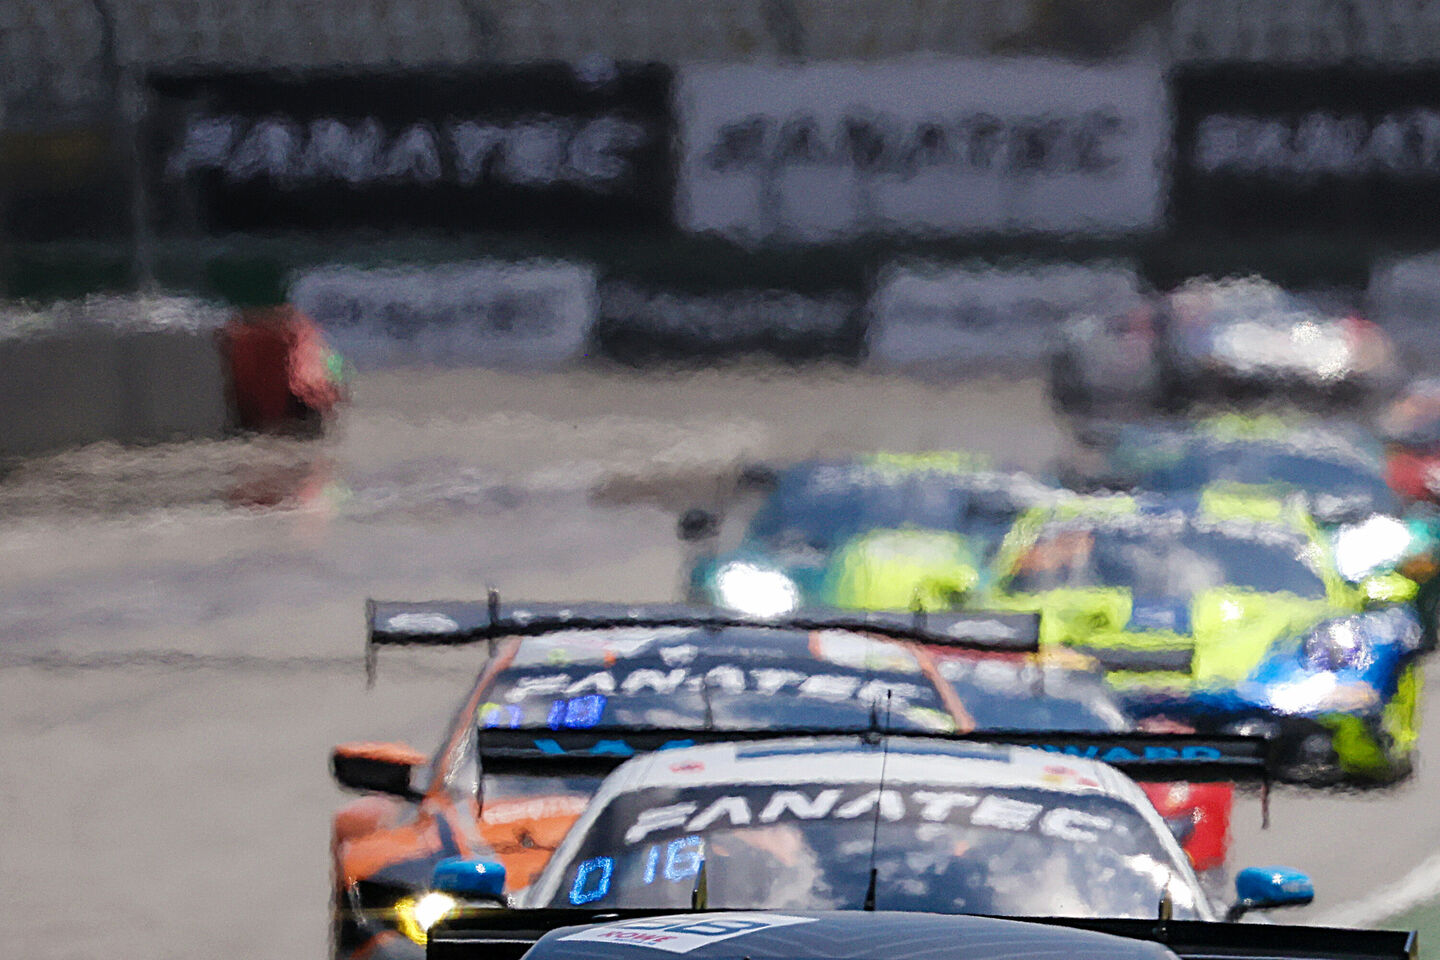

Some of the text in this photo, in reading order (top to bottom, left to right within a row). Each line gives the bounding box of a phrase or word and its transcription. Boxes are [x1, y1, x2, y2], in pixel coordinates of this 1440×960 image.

[164, 114, 644, 184] FANATEC
[707, 108, 1122, 174] FANATEC
[505, 665, 932, 703] FANATEC
[624, 789, 1113, 843] FANATEC
